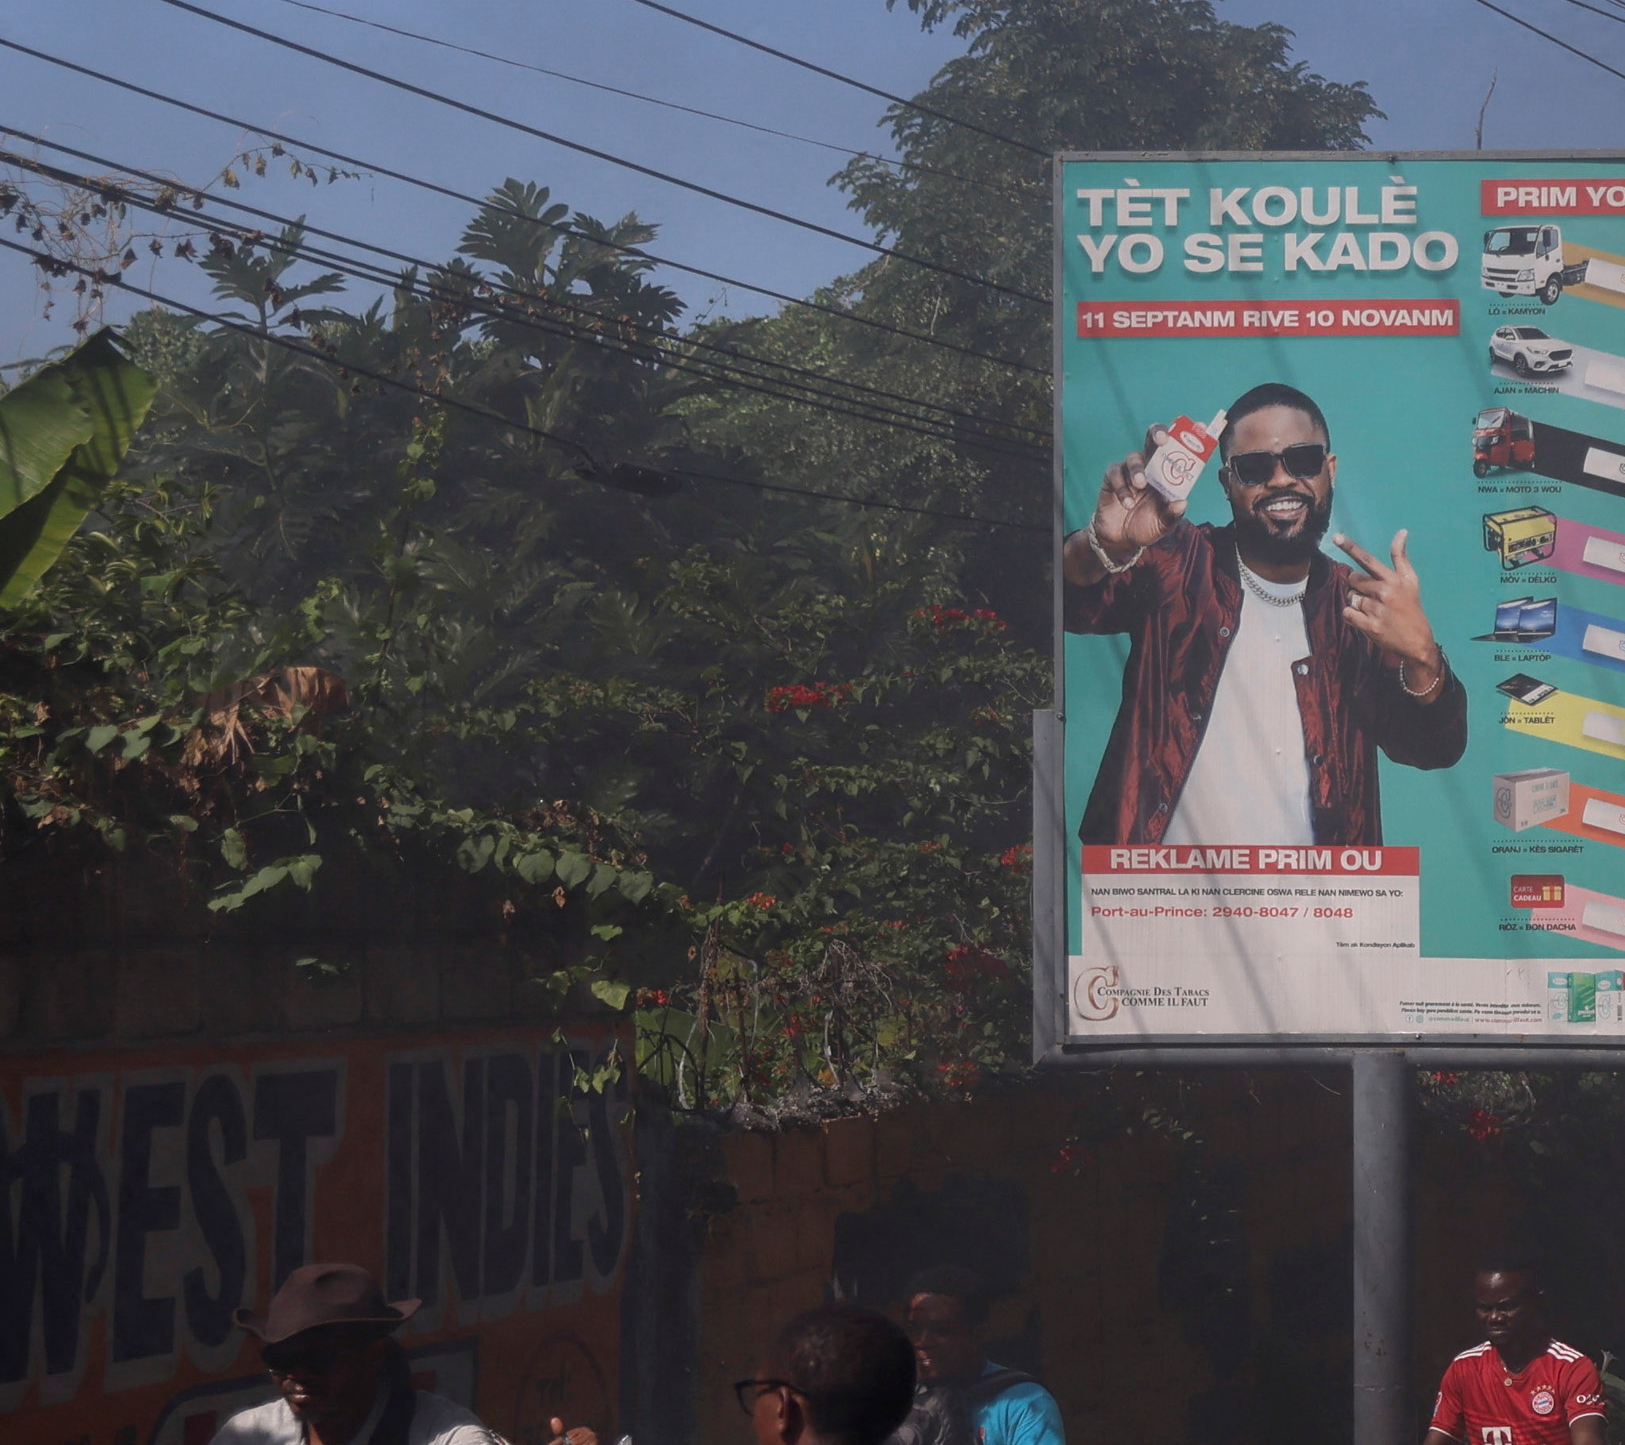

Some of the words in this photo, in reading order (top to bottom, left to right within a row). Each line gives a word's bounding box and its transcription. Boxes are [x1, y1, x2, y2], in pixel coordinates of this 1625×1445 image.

[1077, 178, 1190, 227] TÈT
[1210, 176, 1417, 226] KOULÈ
[1497, 186, 1577, 207] PRIM
[1077, 233, 1164, 273] YO
[1184, 233, 1264, 272] SE
[1284, 231, 1459, 272] KADO
[1082, 312, 1104, 328] 11
[1112, 311, 1235, 328] SEPTANM
[1243, 310, 1299, 328] RIVE
[1305, 310, 1334, 327] 10
[1342, 309, 1453, 327] NOVANM
[1494, 387, 1516, 395] AJAN
[1494, 654, 1510, 662] BLE
[1491, 846, 1521, 854] ORANJ
[1110, 849, 1250, 870] REKLAME
[1259, 849, 1332, 870] PRIM
[1340, 849, 1383, 871] OU
[1091, 888, 1110, 896] NAN
[1112, 888, 1135, 896] BIWO
[1137, 888, 1176, 896] SANTRAL
[1178, 888, 1189, 896] LA
[1191, 888, 1200, 896] KI
[1201, 888, 1221, 896] NAN
[1222, 888, 1265, 896] CLERCINE
[1267, 888, 1293, 896] OSWA
[1318, 889, 1336, 897] NAN
[1338, 889, 1374, 897] NIMEWO
[1375, 889, 1387, 897] SA
[1388, 889, 1404, 897] YO:
[1091, 906, 1207, 917] Port-au-Prince:
[1212, 906, 1299, 918] 2940-8047
[1313, 907, 1353, 918] 8048
[1525, 923, 1544, 931] BON
[1546, 923, 1576, 931] DACHA
[1121, 997, 1165, 1007] COMME
[1167, 997, 1180, 1007] IL
[1181, 997, 1209, 1007] FAUT
[0, 1068, 341, 1381] WEST
[386, 1048, 628, 1307] INDIES
